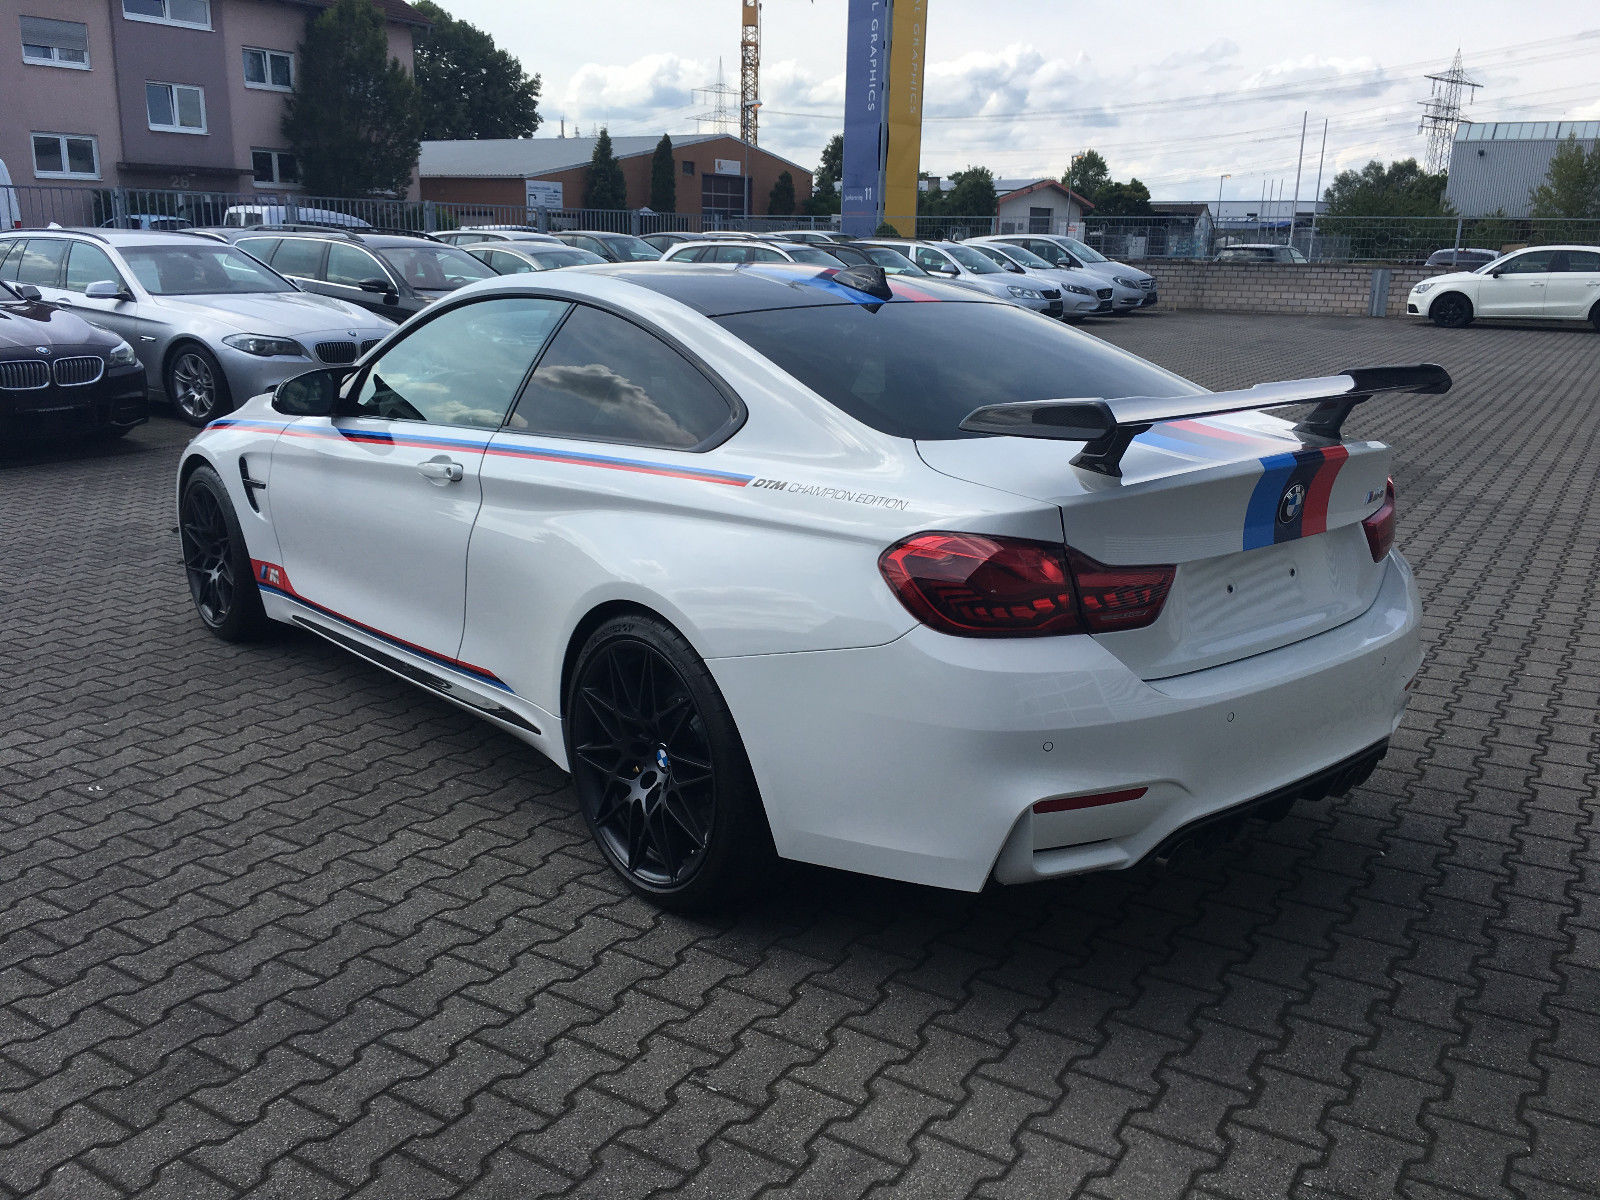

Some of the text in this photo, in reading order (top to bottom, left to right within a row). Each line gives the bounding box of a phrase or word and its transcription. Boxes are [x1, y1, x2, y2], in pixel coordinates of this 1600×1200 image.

[868, 19, 879, 111] GRAPHICS
[752, 478, 909, 511] DTM CHAMPION EDITION
